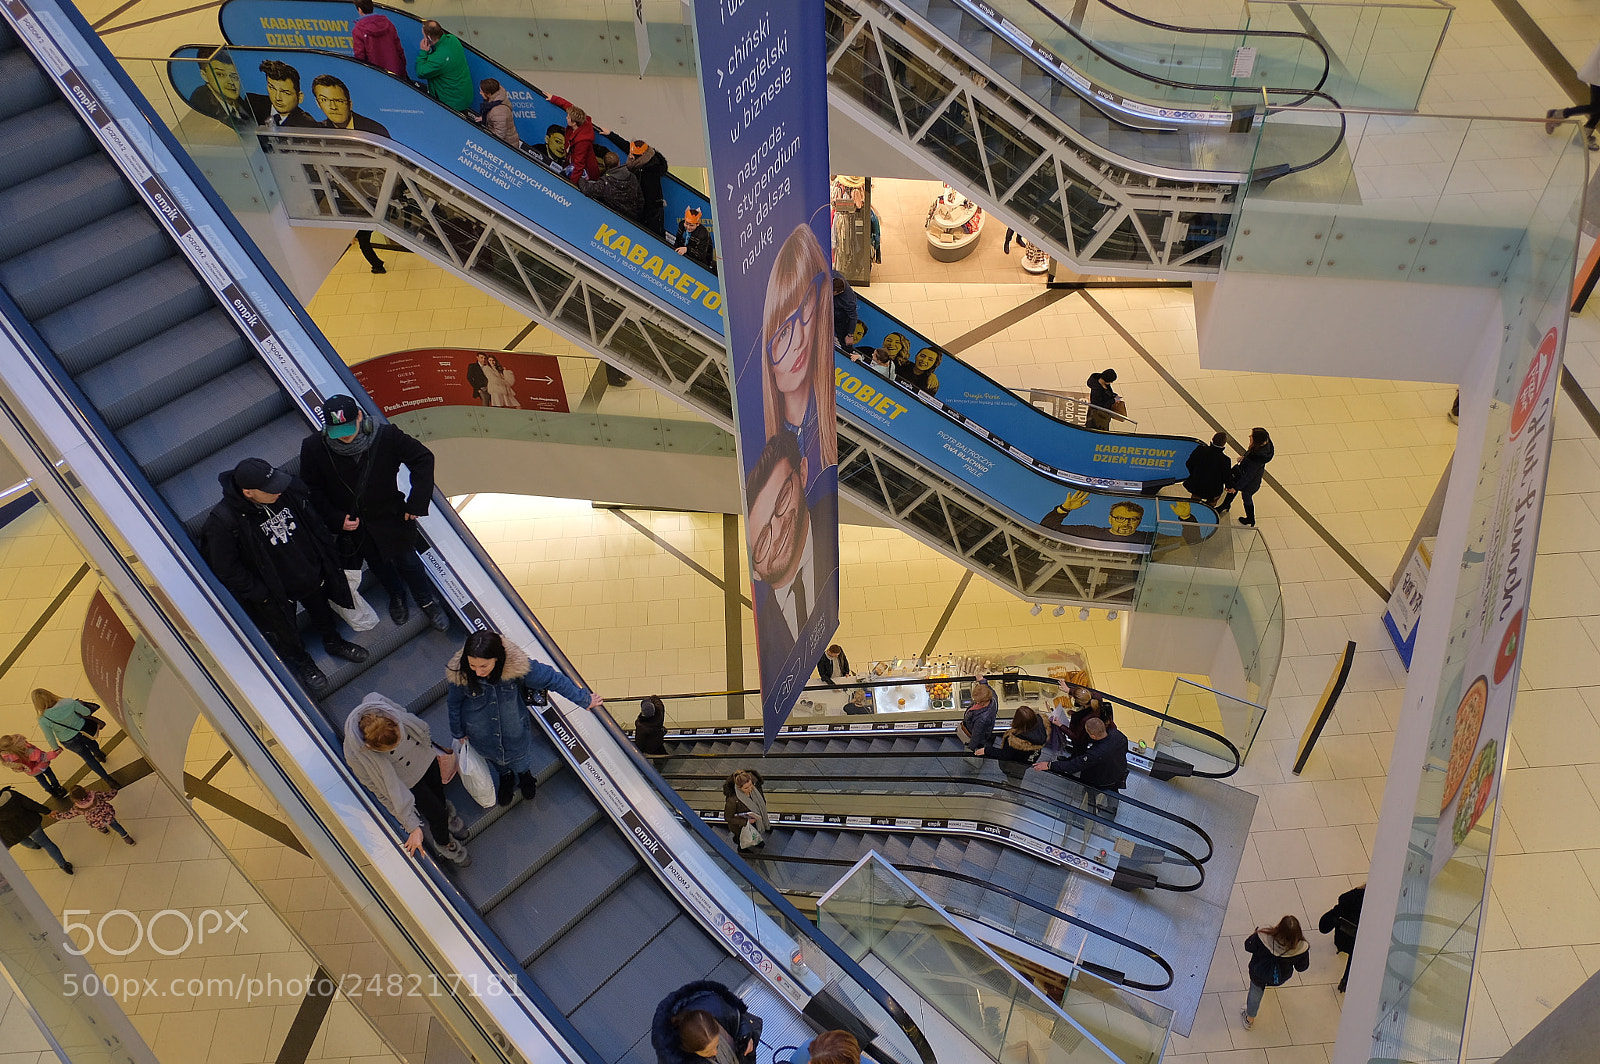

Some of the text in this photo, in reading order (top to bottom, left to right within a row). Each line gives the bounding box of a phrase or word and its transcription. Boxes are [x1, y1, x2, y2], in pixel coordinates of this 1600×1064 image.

[260, 17, 349, 32] KABARETOWY
[266, 30, 305, 47] DZIEŃ
[728, 12, 770, 75] chiński
[728, 90, 732, 112] i
[736, 30, 788, 104] angielski
[72, 85, 98, 114] empik
[506, 91, 533, 100] ARCA
[512, 101, 534, 109] PODEK
[730, 66, 791, 144] w biznesie
[512, 111, 537, 119] WICE
[106, 126, 124, 148] POZIOM
[461, 147, 524, 189] KABARET SMILE
[738, 122, 785, 188] nagroda:
[457, 156, 511, 191] ANI MRU MRU
[465, 139, 572, 208] KABARET MŁODYCH PANÓW
[738, 136, 800, 220] stypendium
[154, 192, 178, 222] empik
[740, 176, 791, 248] na dalszą
[186, 234, 204, 256] POZIOM
[742, 225, 774, 274] naukę
[594, 223, 723, 317] KABARETO
[234, 299, 258, 328] empik
[835, 367, 908, 420] KOBIET
[937, 430, 957, 445] PIOTR
[943, 443, 958, 454] EWA
[1095, 444, 1176, 458] KABARETOWY
[1093, 453, 1174, 468] DZIEŃ KOBIET
[426, 552, 444, 574] POZIOM
[1499, 480, 1536, 622] Lunch
[552, 722, 577, 750] empik
[586, 762, 603, 784] POZIOM
[634, 826, 659, 854] empik
[984, 826, 1002, 834] empik
[669, 865, 688, 887] POZIOM
